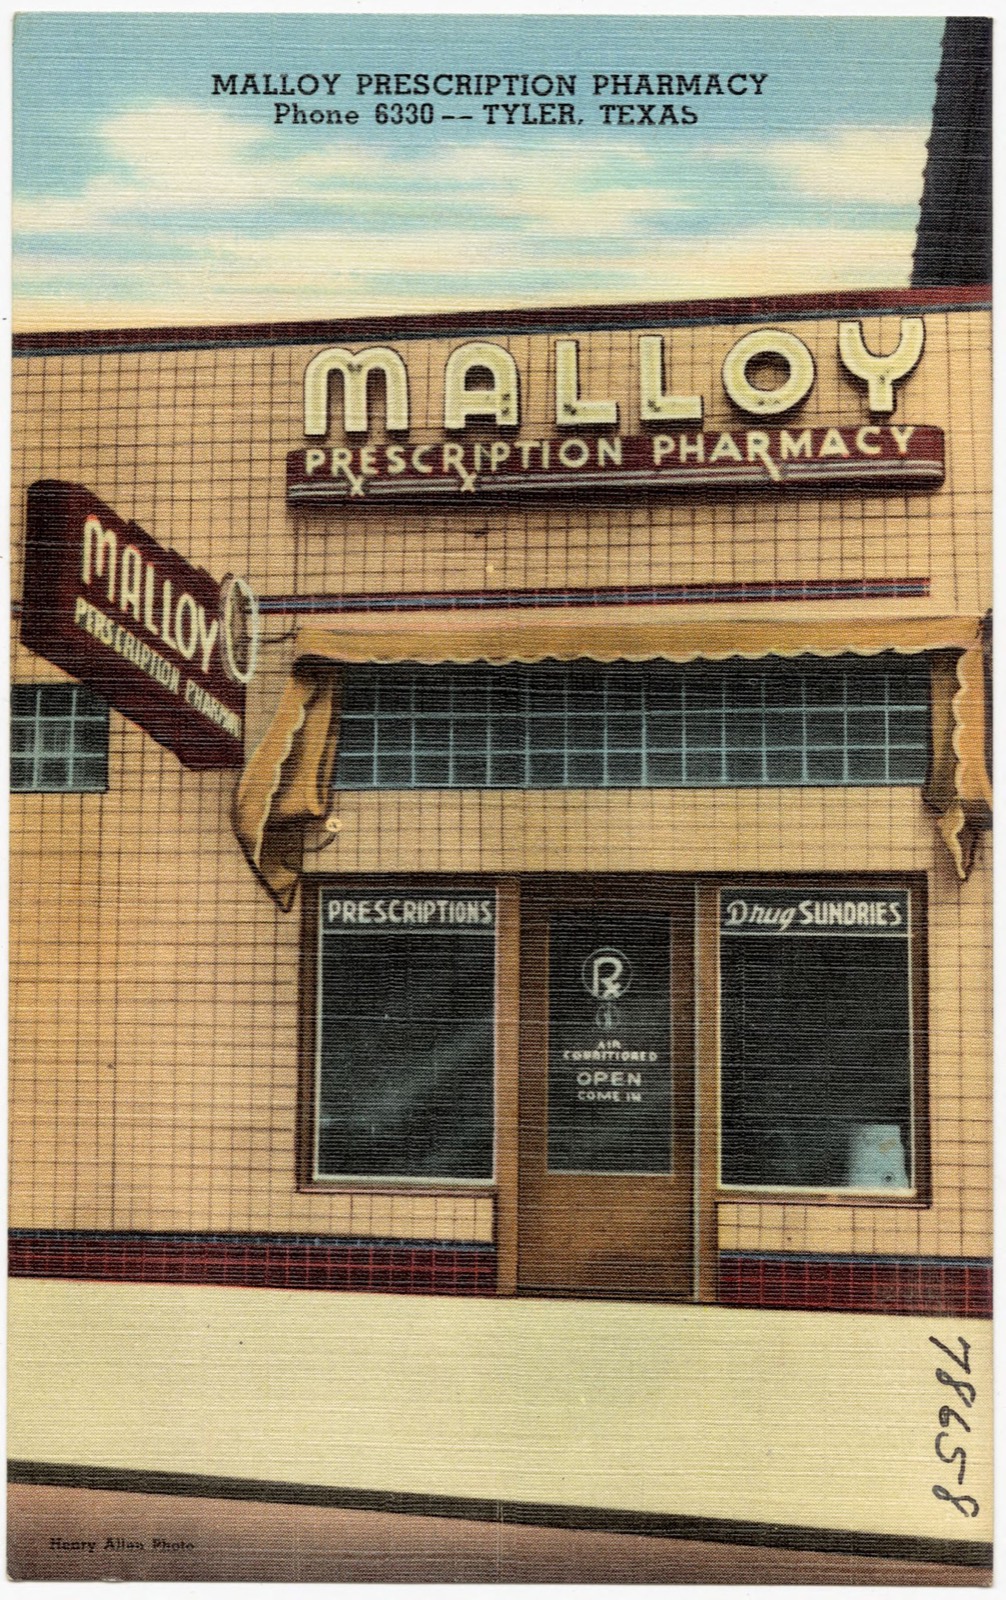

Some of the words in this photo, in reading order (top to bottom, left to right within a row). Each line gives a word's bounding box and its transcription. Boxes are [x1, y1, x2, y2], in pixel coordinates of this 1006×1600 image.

[303, 316, 925, 435] MALLOY
[304, 436, 623, 496] PRESCRIPTION
[652, 425, 918, 481] PHARMACY
[82, 514, 219, 675] MALLOY
[328, 899, 493, 924] PRESCRIPTIONS
[724, 899, 797, 932] Drug
[798, 899, 902, 926] SUNDRIES
[562, 1050, 658, 1062] CONDITIONED
[597, 1039, 621, 1050] AIR
[576, 1071, 642, 1087] OPEN
[577, 1091, 620, 1102] COME
[626, 1091, 642, 1102] IN
